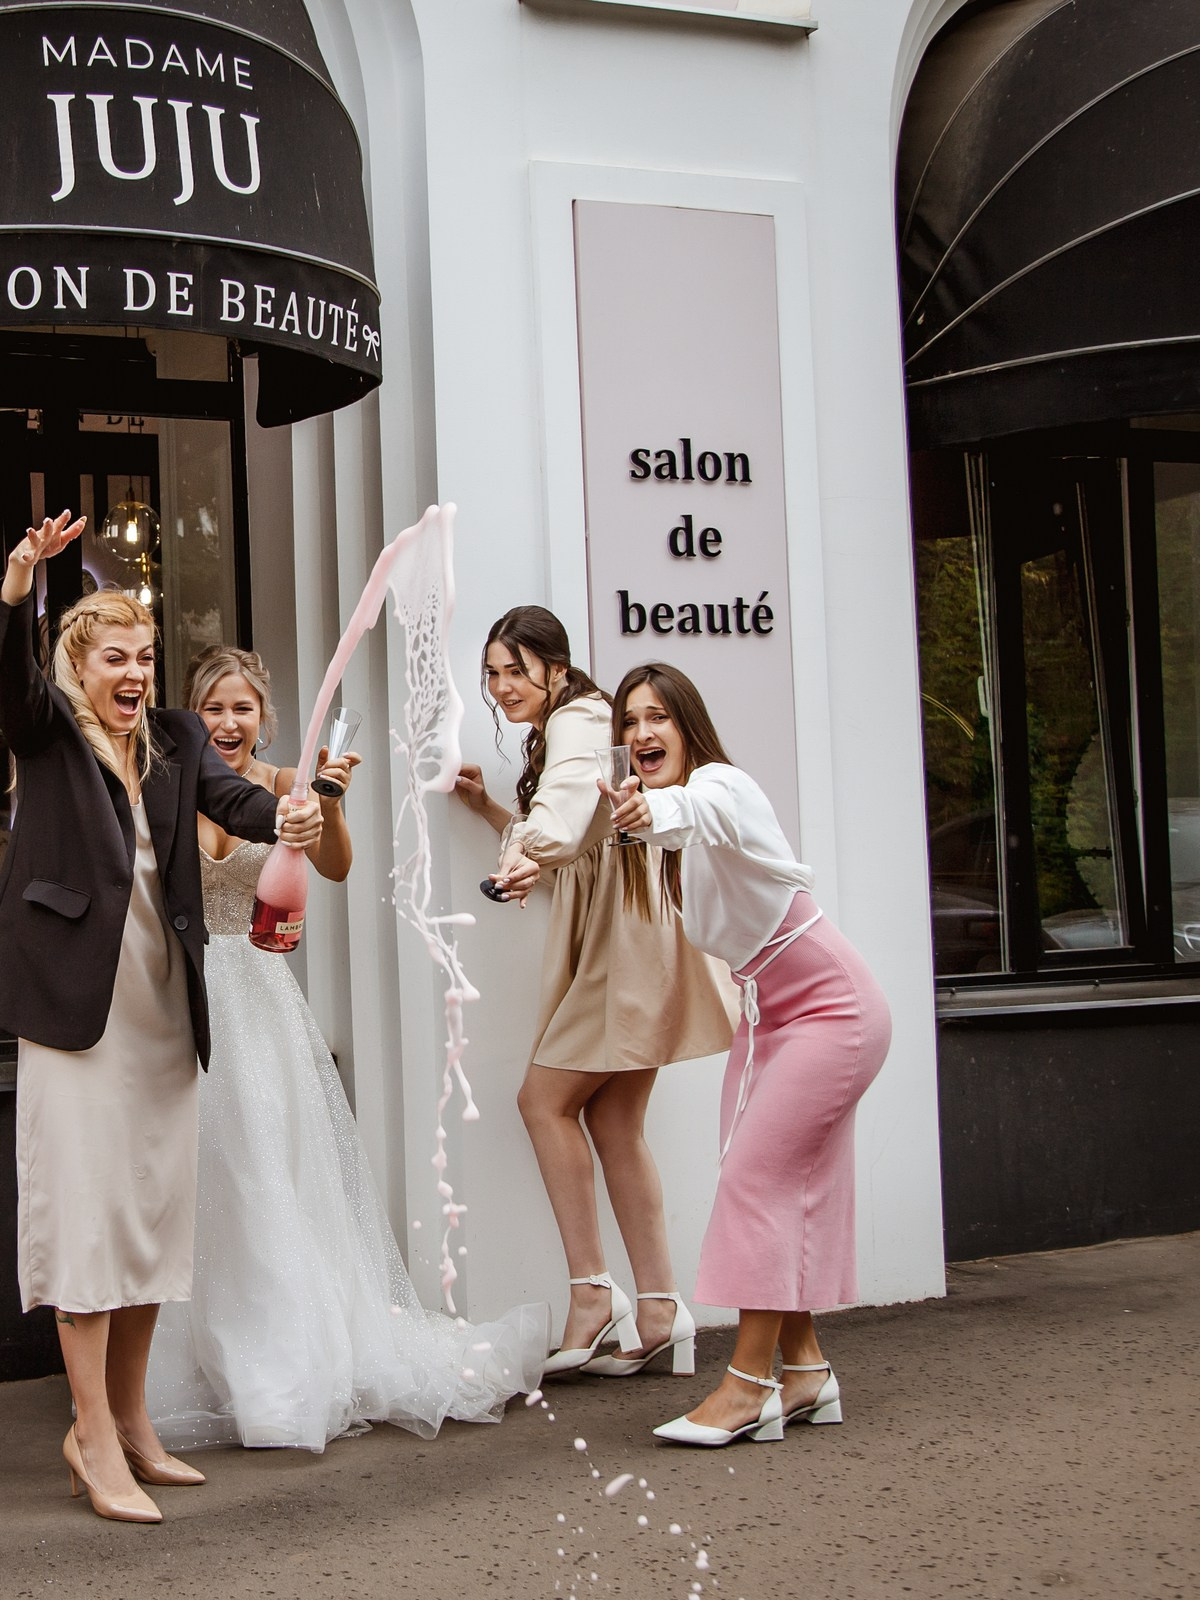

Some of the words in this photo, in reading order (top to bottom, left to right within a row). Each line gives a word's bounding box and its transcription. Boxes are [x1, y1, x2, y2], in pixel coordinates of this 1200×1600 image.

[42, 36, 254, 91] MADAME
[46, 93, 261, 206] JUJU
[122, 268, 194, 316] DE
[219, 278, 359, 353] BEAUTÉ
[629, 437, 753, 486] salon
[668, 514, 723, 560] de
[616, 589, 774, 637] beauté
